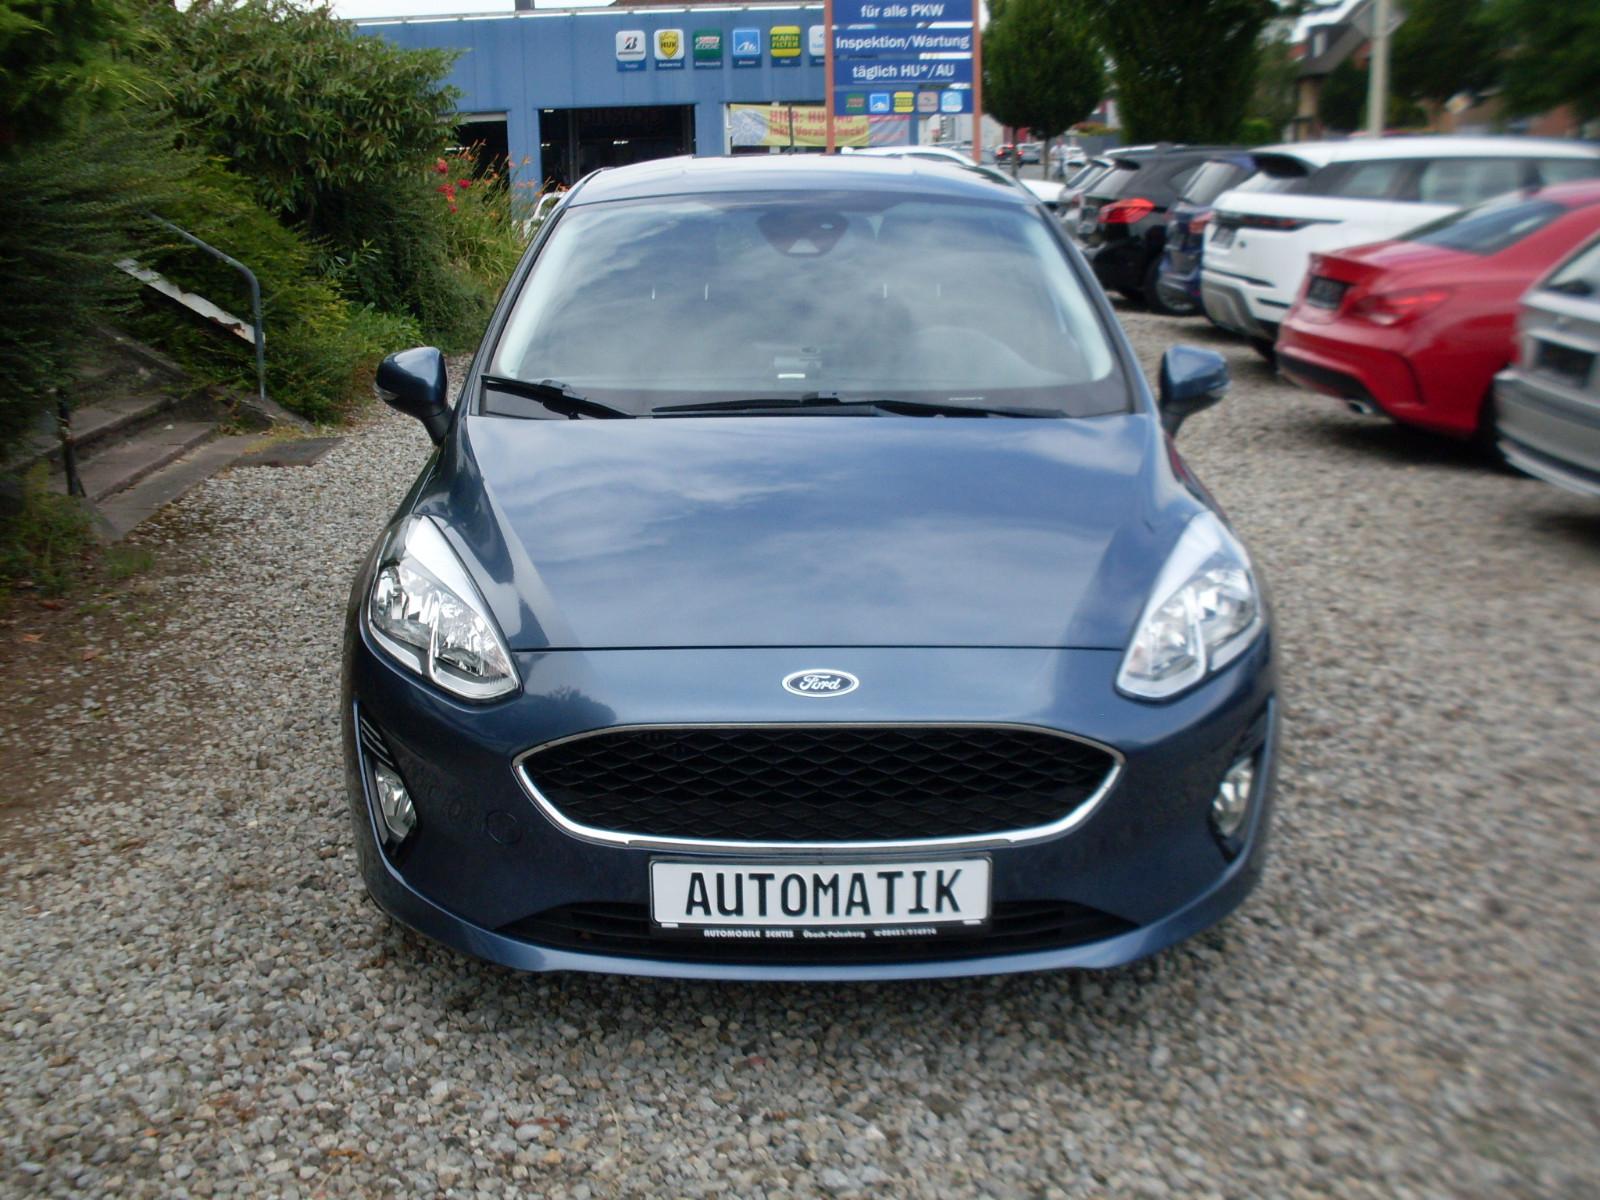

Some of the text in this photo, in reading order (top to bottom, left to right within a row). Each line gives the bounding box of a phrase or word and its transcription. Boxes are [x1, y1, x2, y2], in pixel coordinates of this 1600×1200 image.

[860, 4, 945, 18] für alle PKW
[835, 35, 970, 51] Inspektion/Wartung
[852, 64, 898, 80] täglich
[799, 674, 842, 691] Ford
[684, 868, 963, 917] AUTOMATIK
[703, 929, 761, 938] AUTOMOBILE
